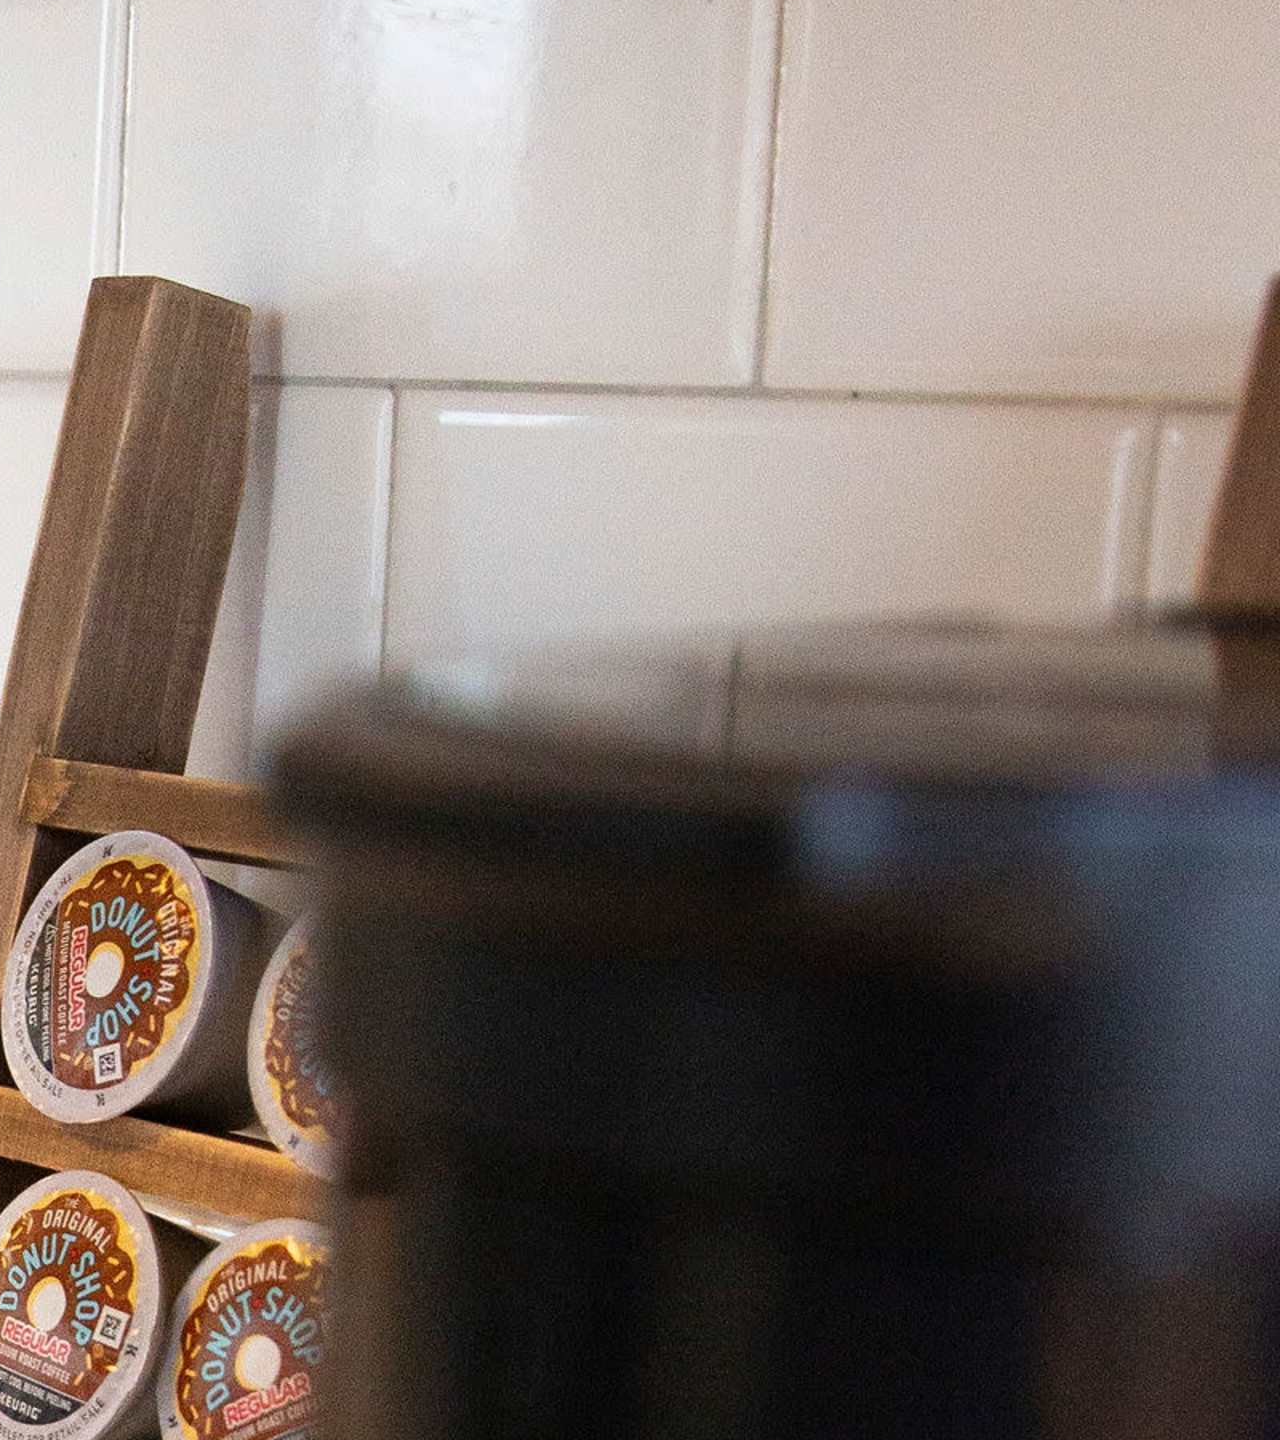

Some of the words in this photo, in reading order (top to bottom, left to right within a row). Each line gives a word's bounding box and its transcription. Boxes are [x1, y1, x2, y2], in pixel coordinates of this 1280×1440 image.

[91, 895, 161, 963] DONUT
[153, 901, 184, 1007] ORIGINAL
[26, 962, 40, 1026] KEURIG
[57, 965, 70, 1001] ROAST
[69, 924, 90, 1033] REGULAR
[86, 975, 153, 1046] SHOP
[42, 1209, 115, 1254] ORIGINAL
[70, 1250, 102, 1345] SHOP
[205, 1258, 289, 1313] ORIGINAL
[1, 1316, 71, 1364] REGULAR
[201, 1288, 254, 1411] DONUT
[260, 1285, 322, 1367] SHOP
[41, 1360, 72, 1385] COFFEE
[223, 1372, 312, 1431] REGULAR
